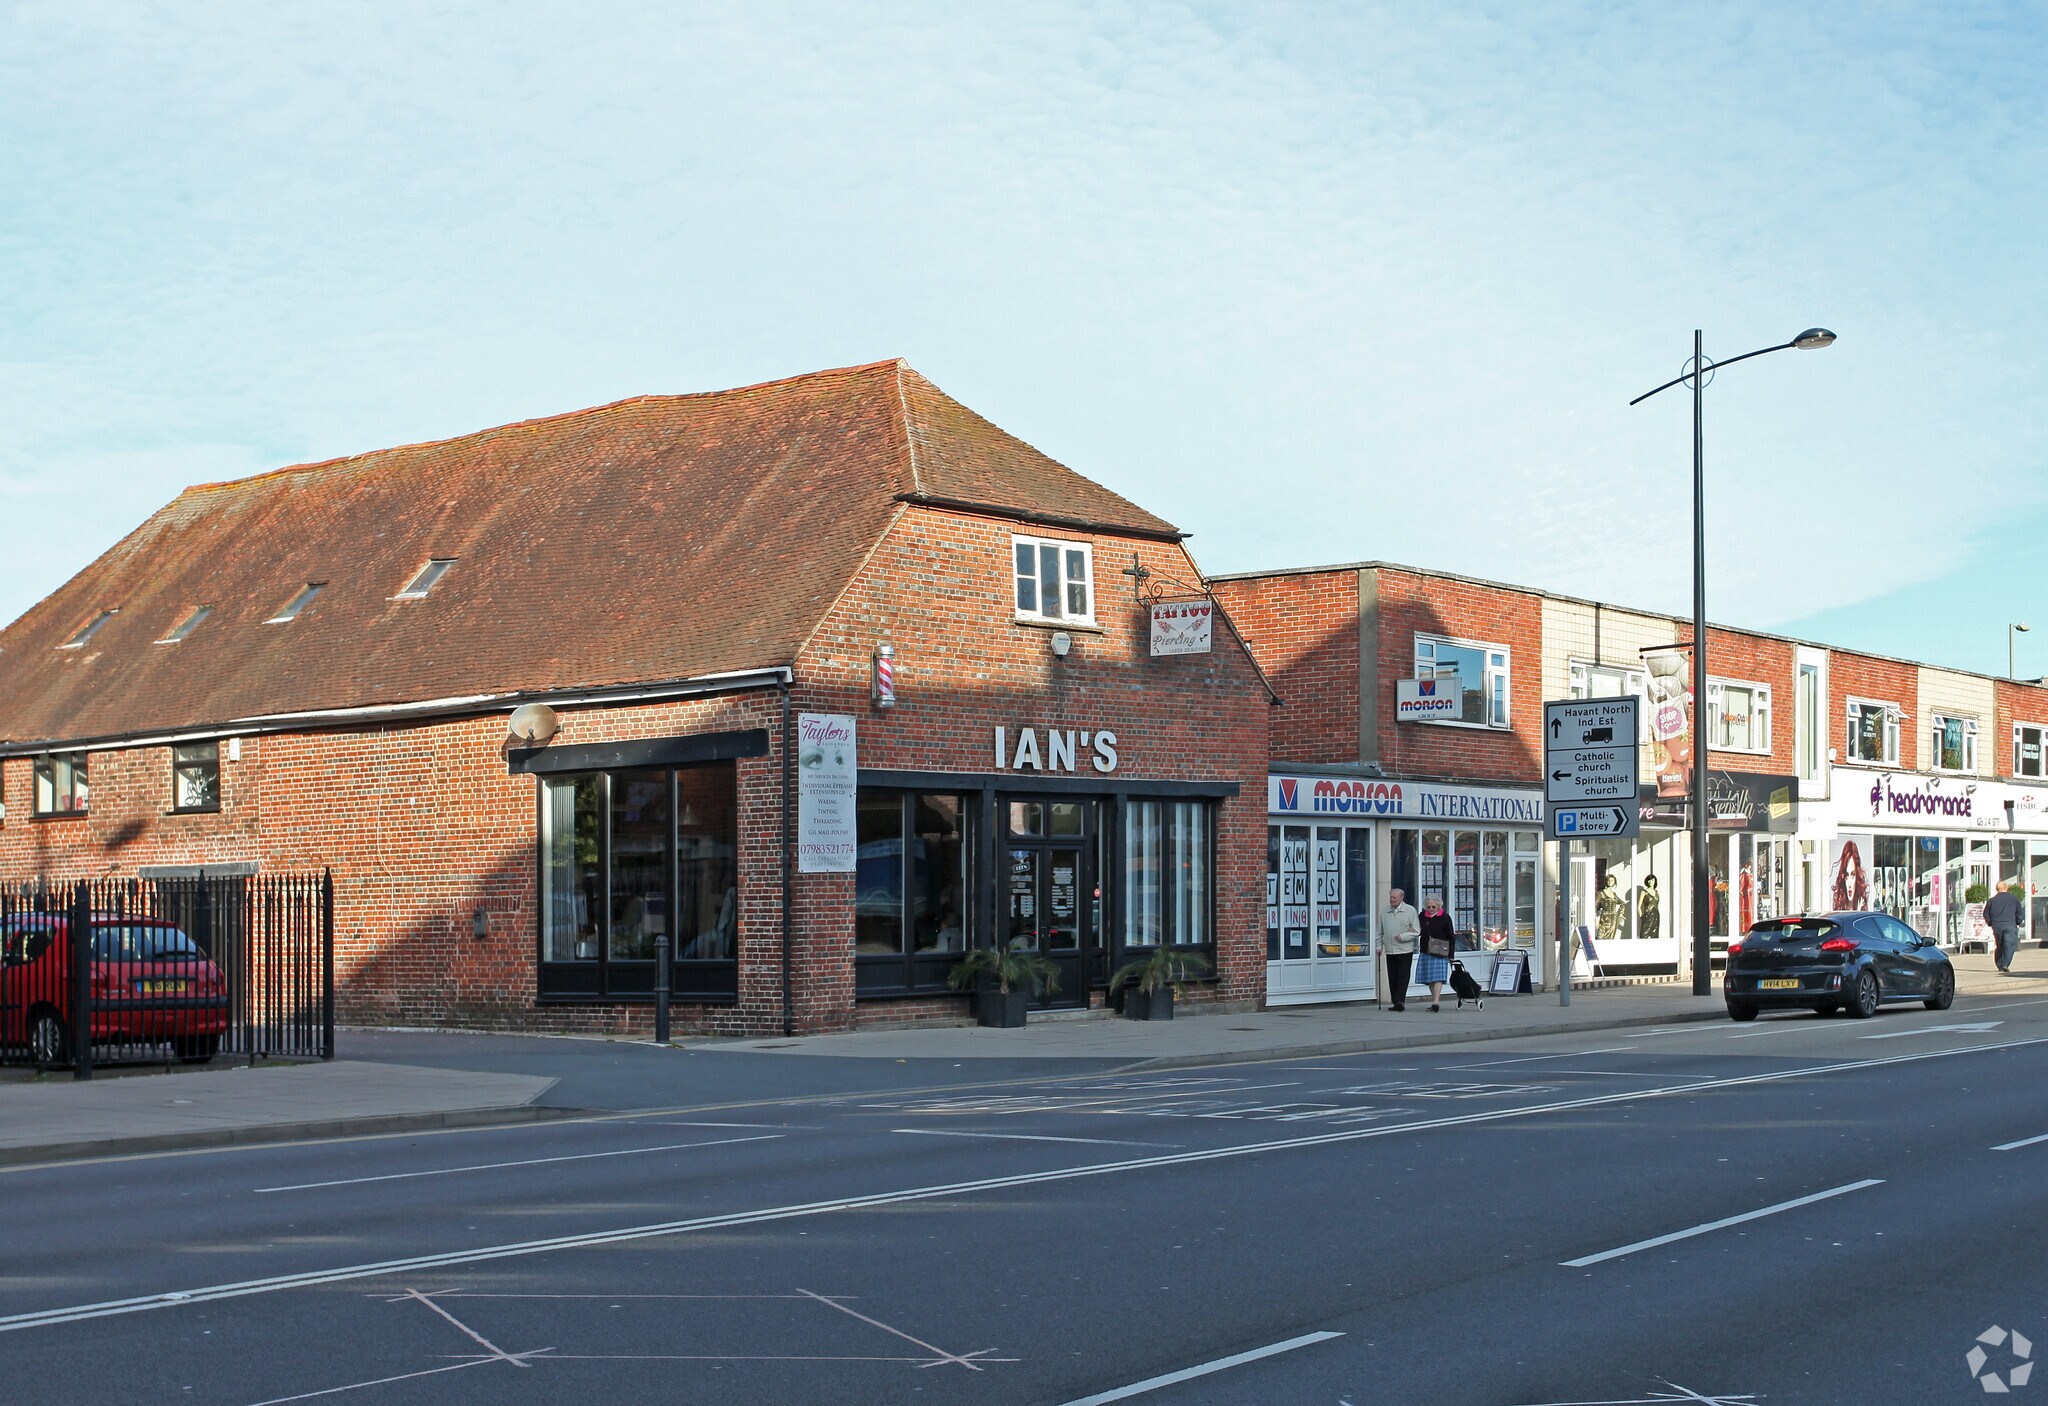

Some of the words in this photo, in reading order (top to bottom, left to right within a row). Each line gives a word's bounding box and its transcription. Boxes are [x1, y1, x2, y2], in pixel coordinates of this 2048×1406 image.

[1153, 603, 1211, 619] TATTOO
[1153, 635, 1197, 647] Piercing
[1564, 707, 1599, 717] Havant
[1602, 704, 1631, 714] North
[1660, 710, 1678, 724] SHOP
[1578, 718, 1597, 726] Ind.
[1598, 716, 1617, 725] Est.
[801, 719, 850, 746] Taylors
[995, 725, 1118, 773] IAN'S
[1574, 751, 1615, 762] Catholic
[1578, 762, 1611, 772] church
[1575, 774, 1629, 787] Spiritualist
[1661, 773, 1682, 782] Havant
[1584, 786, 1618, 795] church
[1314, 780, 1402, 815] MORSON
[1419, 792, 1543, 821] INTERNATIONAL
[1887, 784, 1972, 817] headromance
[1580, 810, 1608, 820] Multi-
[1562, 814, 1574, 830] P
[1579, 821, 1610, 832] storey
[801, 844, 854, 854] 07983521774
[1267, 878, 1335, 897] TEMPS
[1317, 908, 1339, 923] NOW
[1763, 980, 1780, 988] HV14
[1780, 980, 1797, 988] LXY
